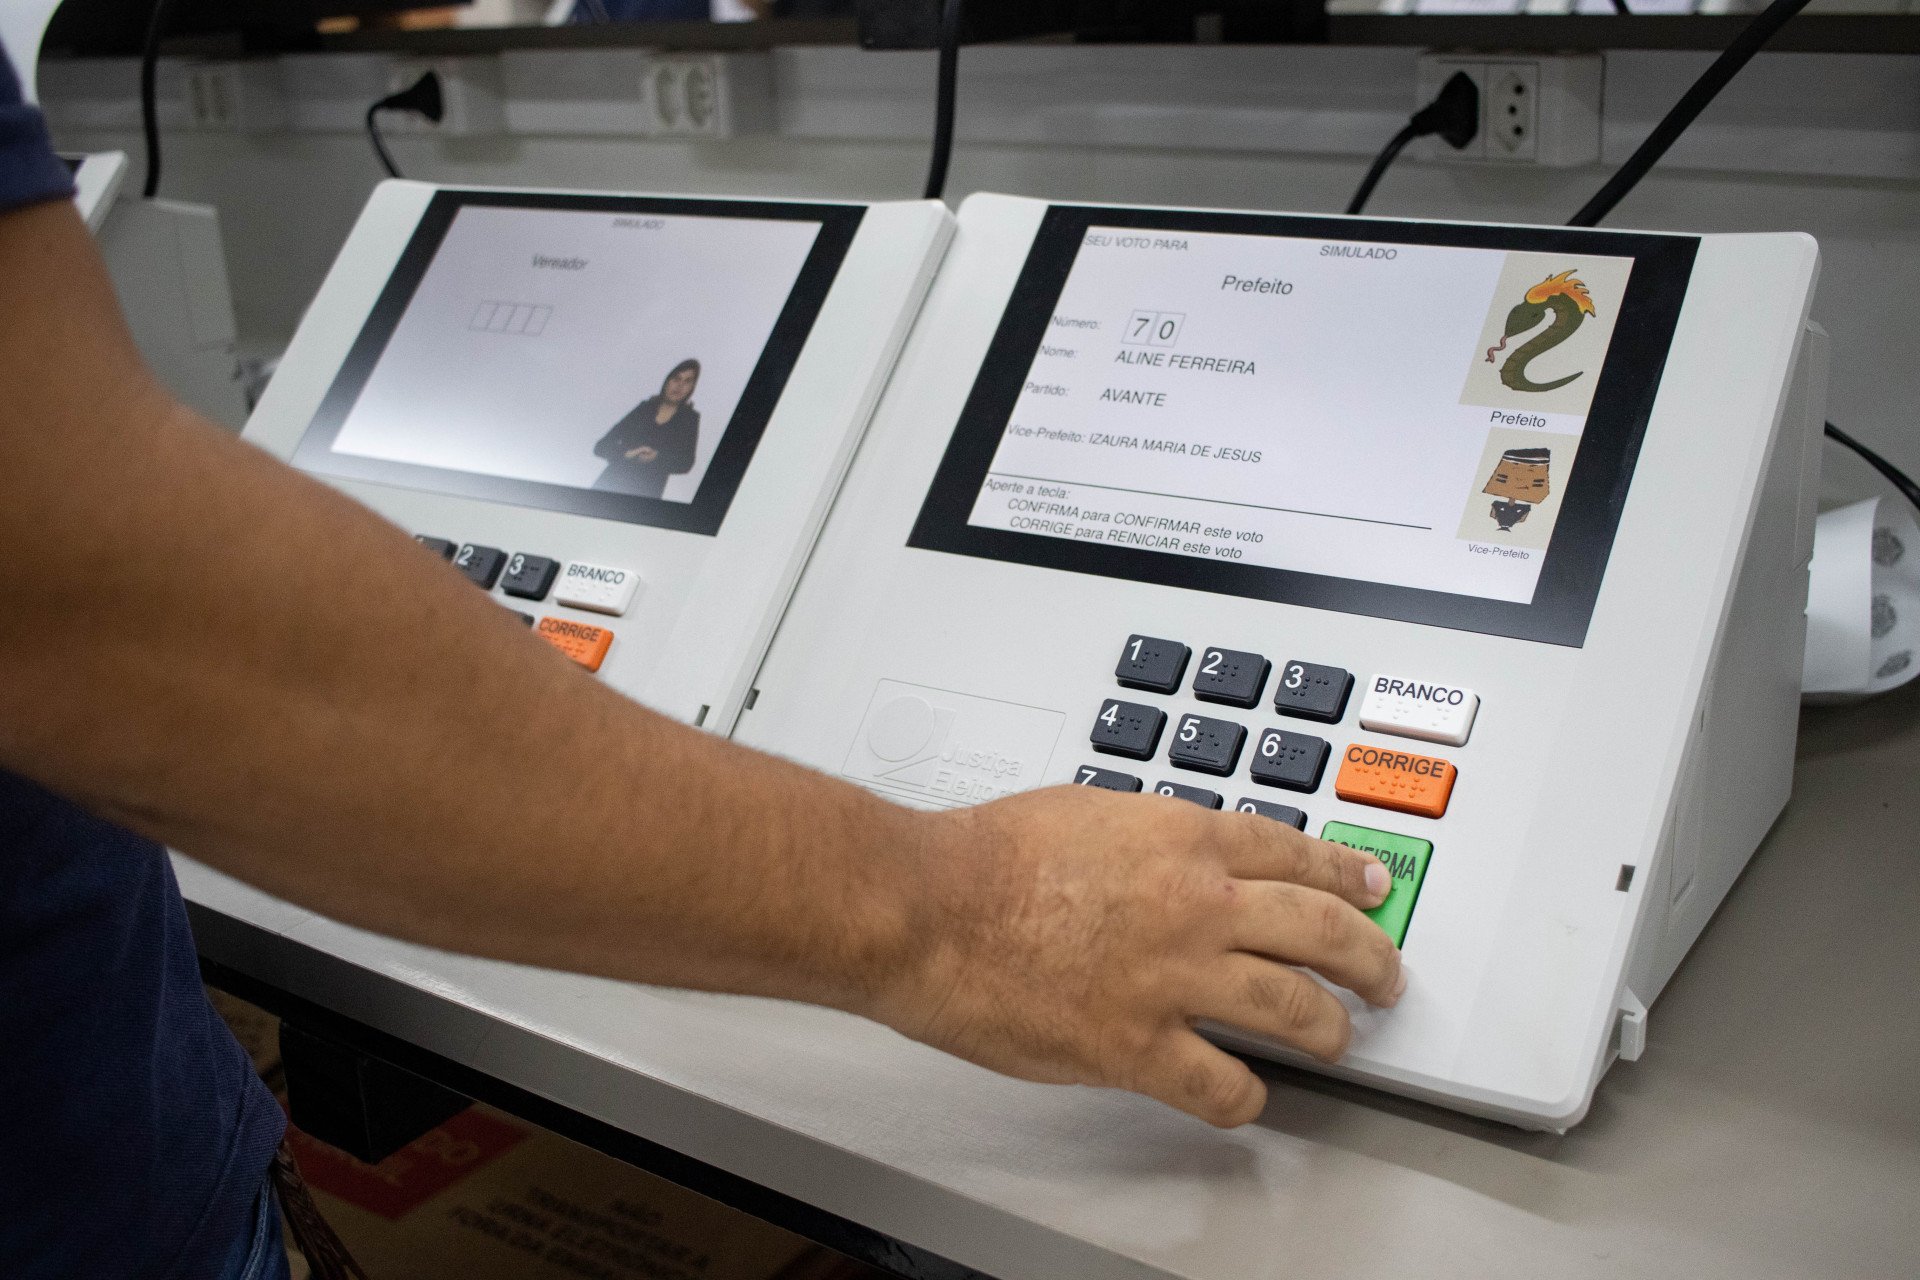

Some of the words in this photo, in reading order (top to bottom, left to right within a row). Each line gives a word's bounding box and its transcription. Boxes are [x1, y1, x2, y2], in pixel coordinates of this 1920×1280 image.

[1084, 235, 1112, 247] SEU
[1115, 237, 1151, 249] VOTO
[1153, 238, 1189, 251] PARA
[1319, 244, 1398, 261] SIMULADO
[532, 253, 588, 271] Vereador
[1221, 275, 1293, 296] Prefeito
[1052, 315, 1101, 330] Número:
[1114, 350, 1165, 367] ALINE
[1168, 355, 1256, 375] FERREIRA
[1024, 382, 1070, 397] Partido:
[1100, 388, 1167, 407] AVANTE
[1490, 410, 1547, 429] Prefeito
[1008, 424, 1084, 443] Vice-Prefeito:
[1089, 433, 1139, 449] IZAURA
[1141, 439, 1187, 455] MARIA
[1190, 444, 1211, 458] DE
[1213, 447, 1262, 464] JESUS
[985, 478, 1024, 494] Aperte
[1026, 485, 1035, 495] a
[1038, 484, 1071, 500] tecla:
[1008, 498, 1079, 518] CONFIRMA
[1081, 510, 1110, 523] para
[1114, 512, 1201, 536] CONFIRMAR
[1203, 526, 1232, 540] este
[1235, 530, 1264, 544] voto
[1010, 516, 1074, 535] CORRIGE
[1075, 526, 1103, 540] para
[1106, 529, 1180, 552] REINICIAR
[1182, 541, 1211, 555] este
[1214, 545, 1243, 560] voto
[457, 545, 474, 566] 2
[1467, 543, 1530, 560] Vice-Prefeito
[509, 554, 525, 576] 3
[567, 564, 626, 585] BRANCO
[539, 619, 601, 642] CORRIGE
[1129, 639, 1145, 661] 1
[1201, 651, 1223, 675] 2
[1285, 665, 1305, 688] 3
[1374, 677, 1464, 706] BRANCO
[1100, 704, 1117, 726] 4
[1179, 718, 1201, 742] 5
[1261, 733, 1280, 757] 6
[940, 744, 1024, 779] Justiça
[1347, 747, 1445, 779] CORRIGE
